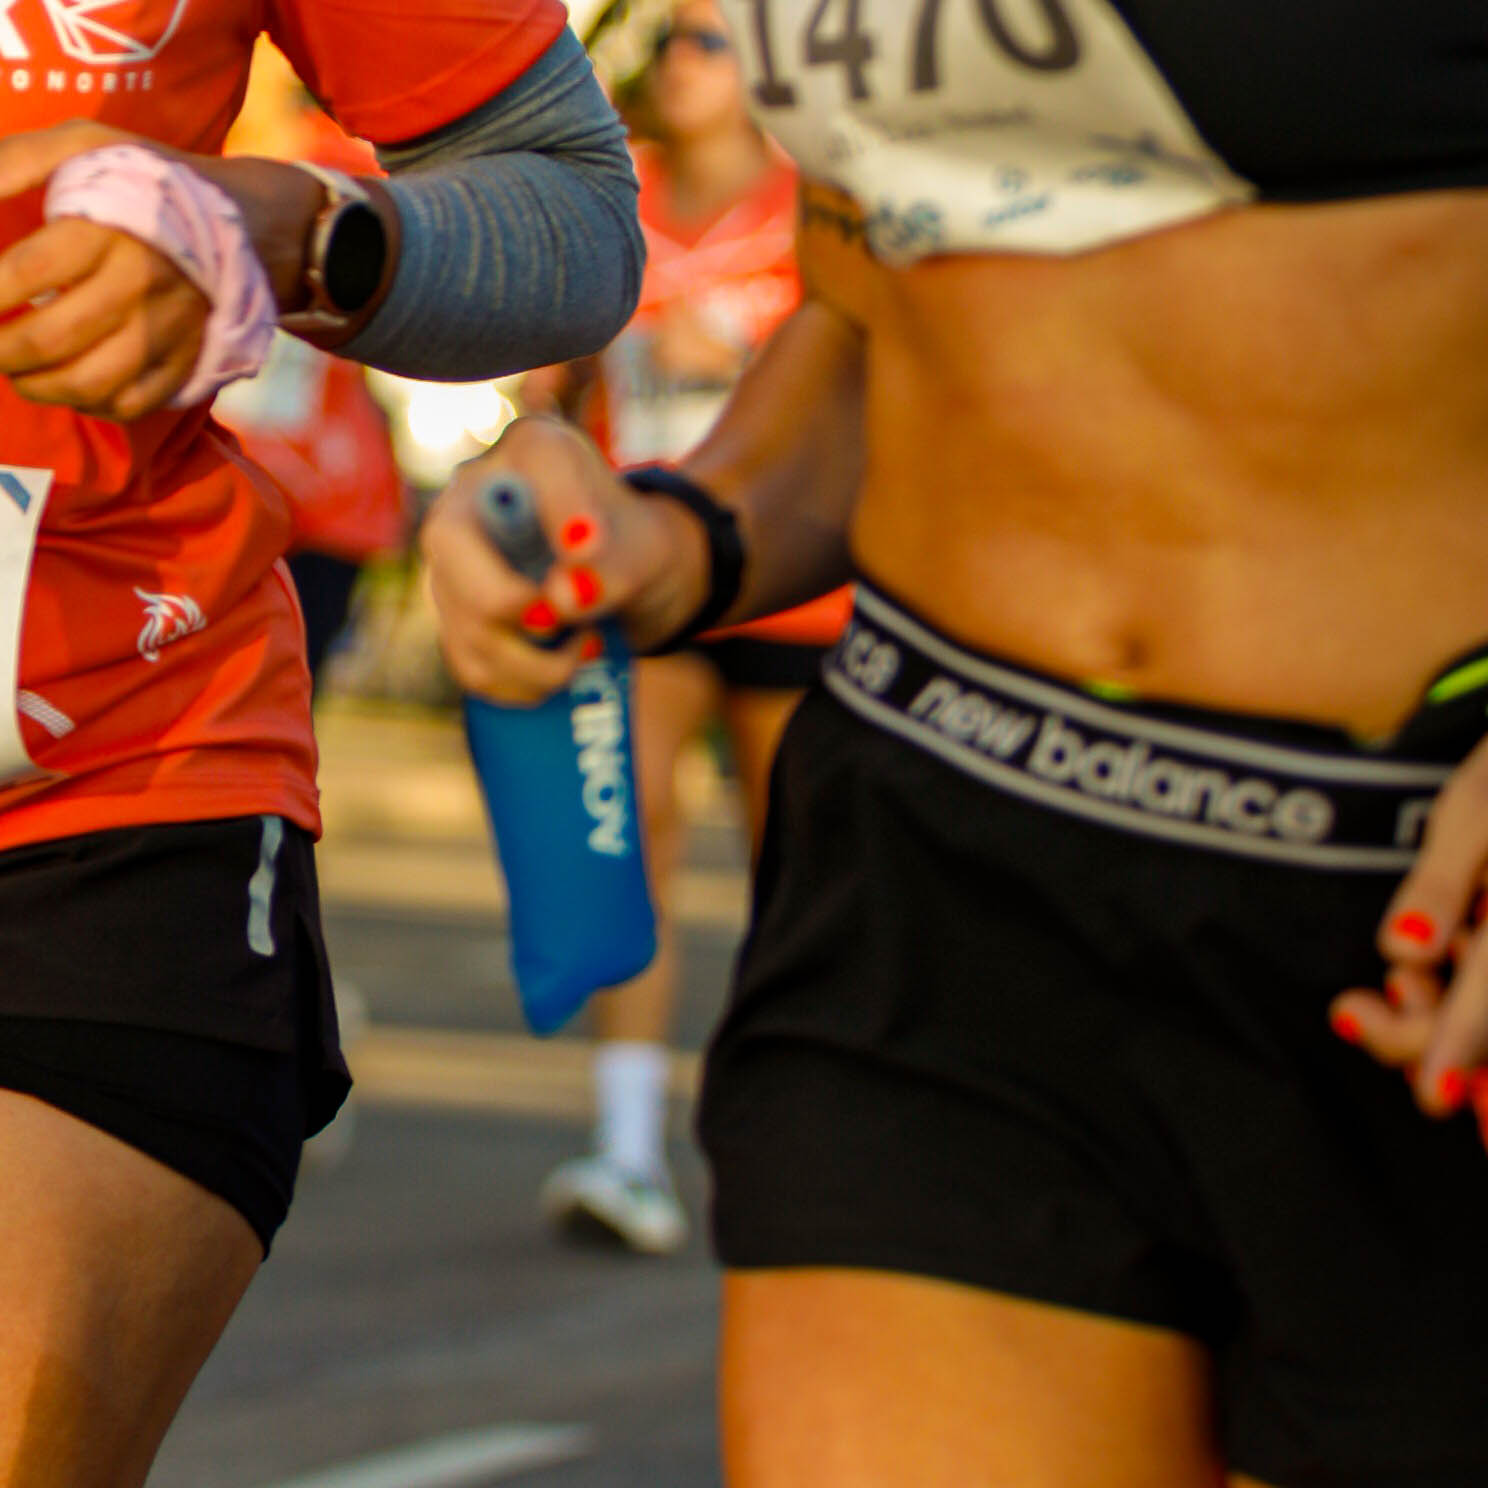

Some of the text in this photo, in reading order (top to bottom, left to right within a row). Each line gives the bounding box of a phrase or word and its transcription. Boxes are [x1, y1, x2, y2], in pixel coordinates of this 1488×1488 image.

[47, 69, 154, 93] NORTE
[909, 675, 1034, 759] new
[1028, 715, 1336, 844] balance
